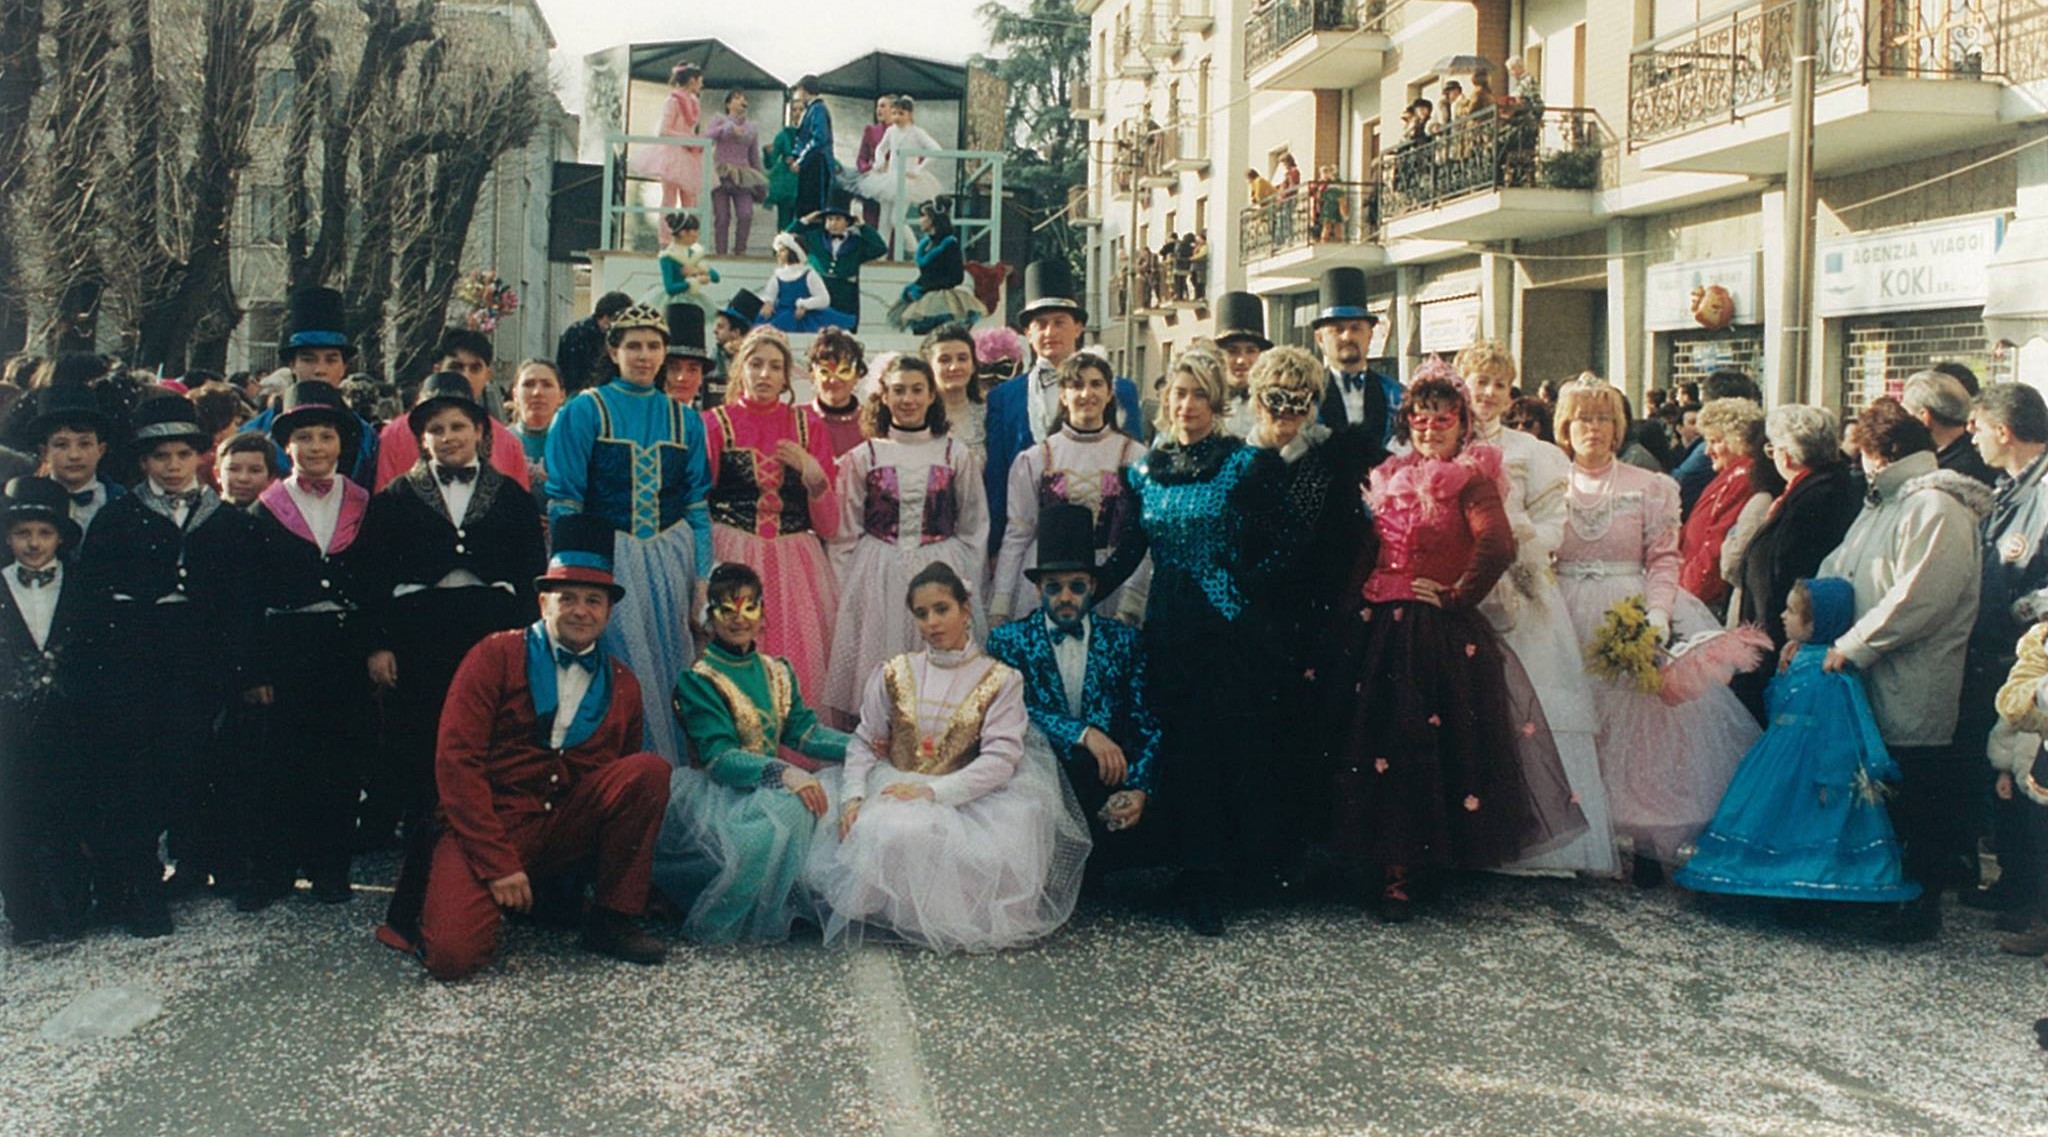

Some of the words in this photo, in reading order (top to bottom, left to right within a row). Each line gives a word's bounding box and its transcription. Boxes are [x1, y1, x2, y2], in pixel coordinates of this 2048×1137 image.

[1852, 241, 1918, 264] AGENZIA
[1929, 232, 1984, 255] VIAGGI
[1880, 265, 1933, 298] KOKI
